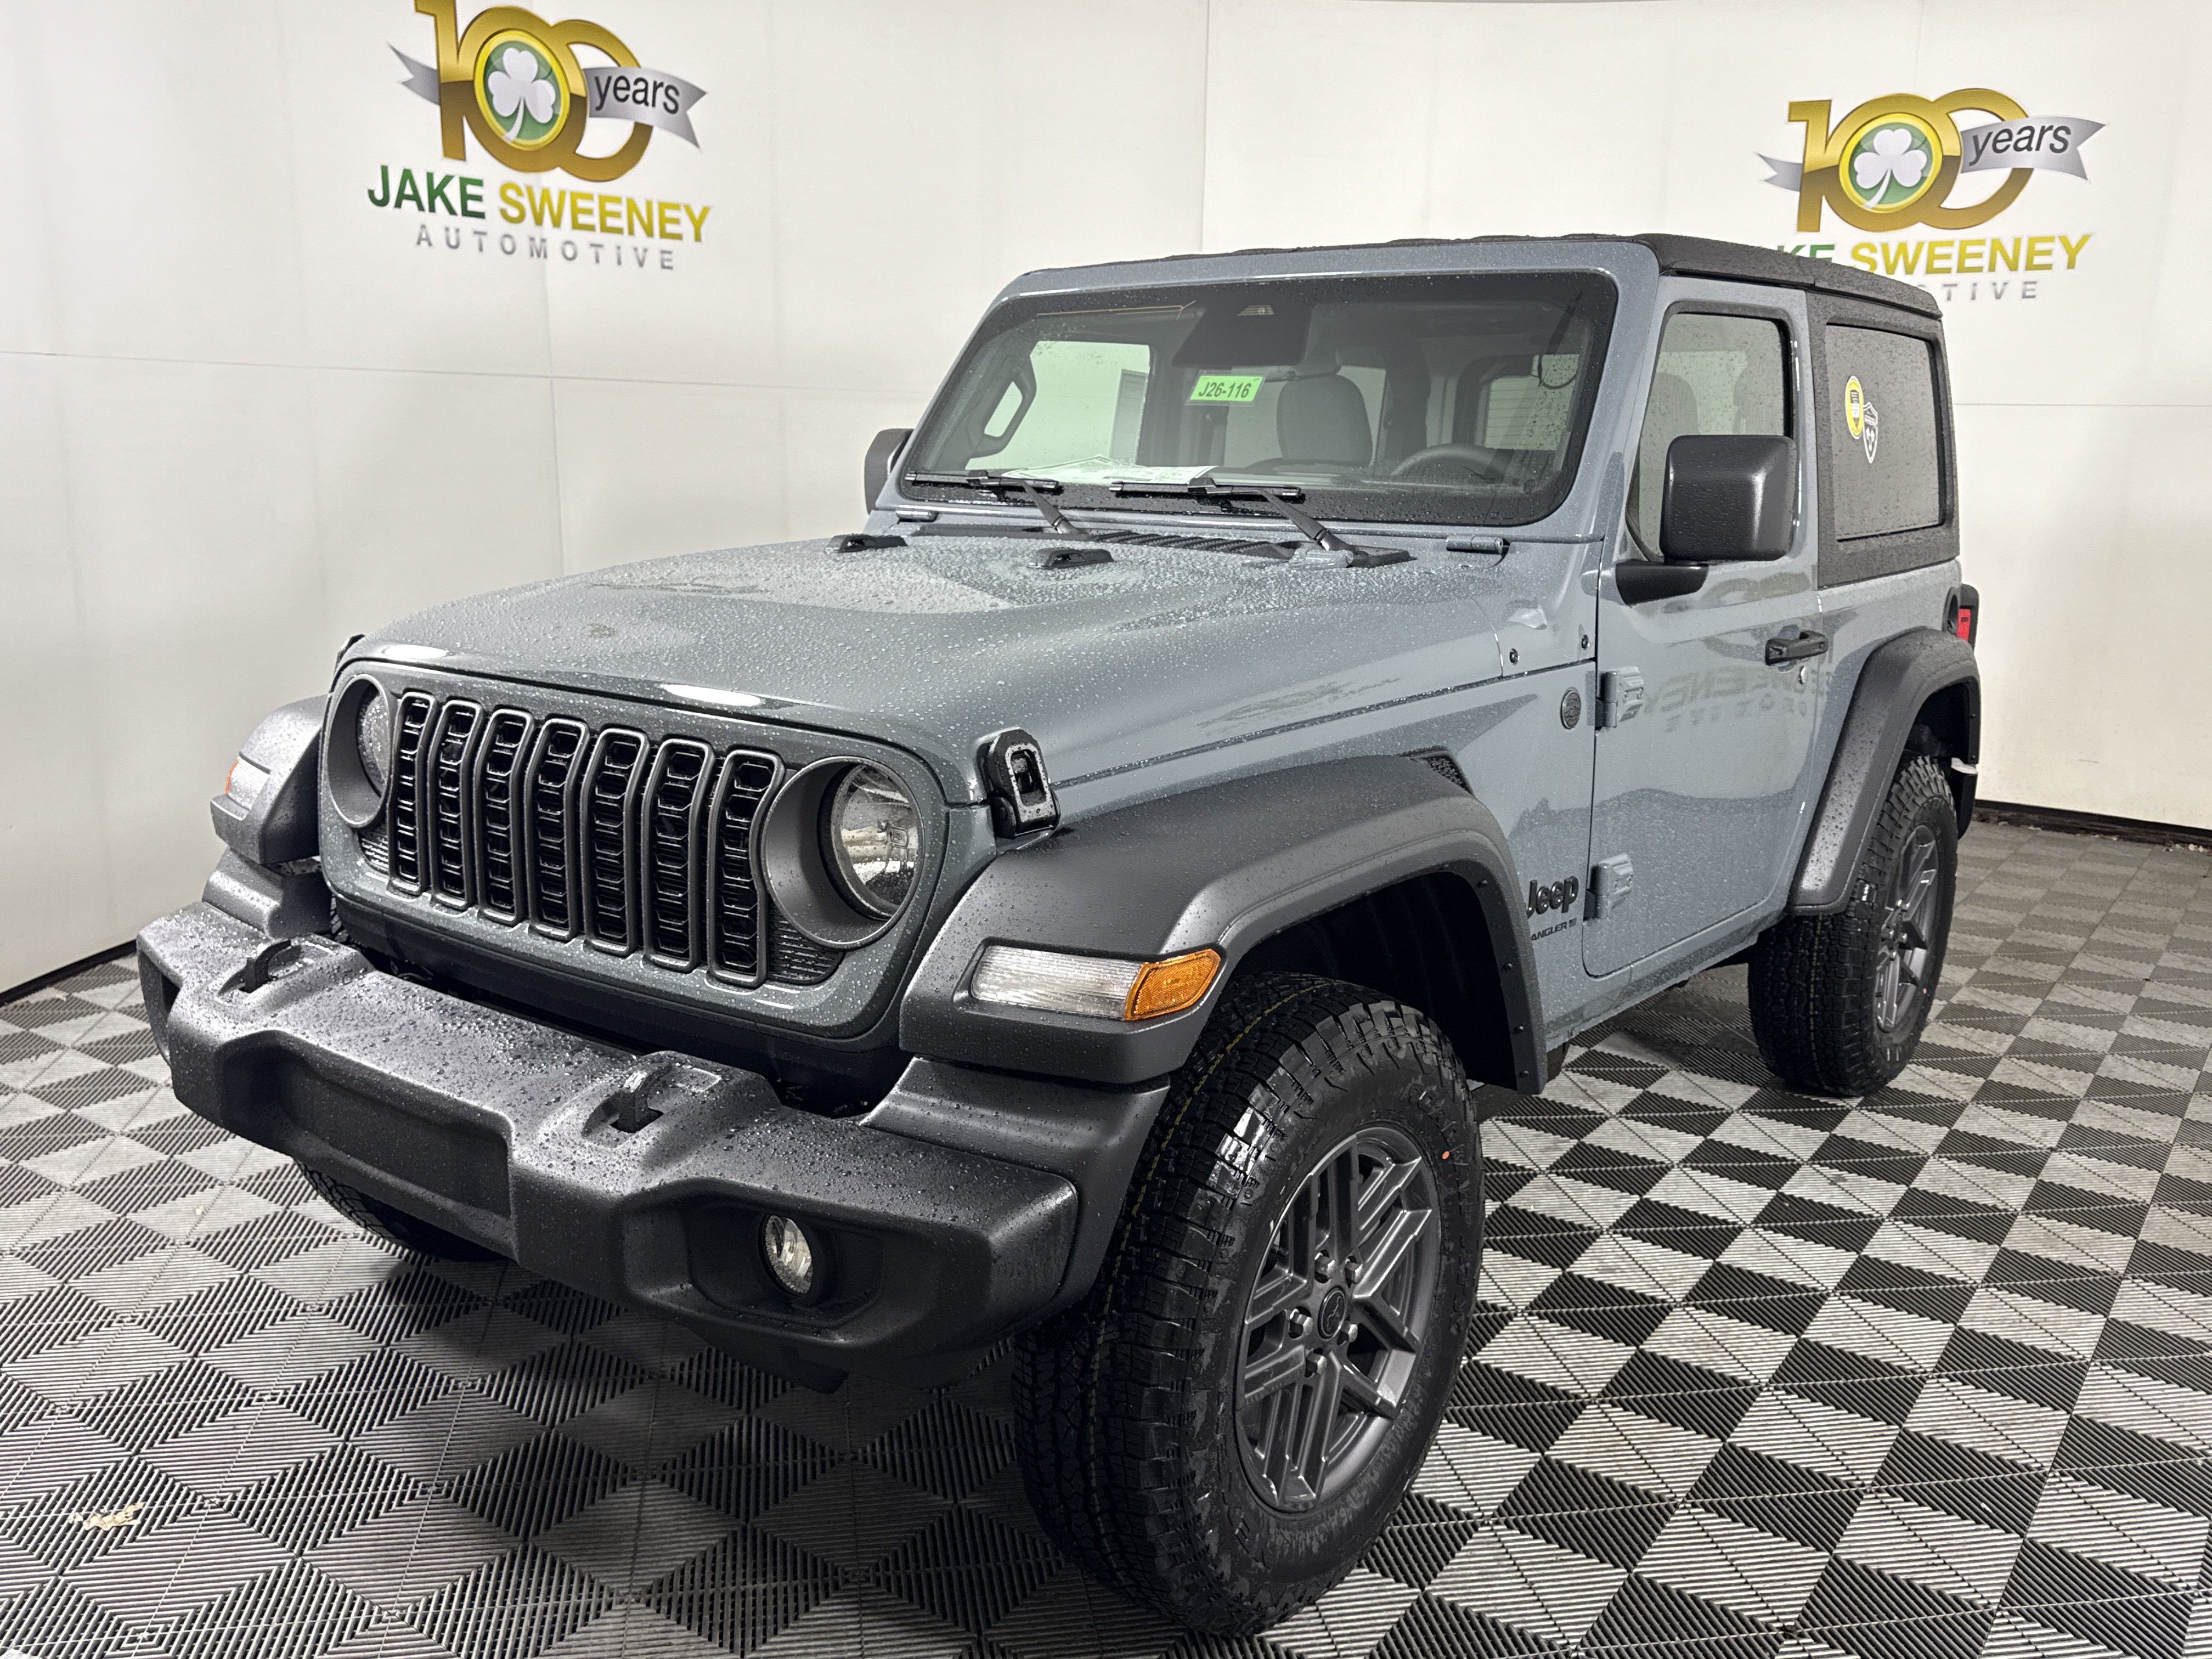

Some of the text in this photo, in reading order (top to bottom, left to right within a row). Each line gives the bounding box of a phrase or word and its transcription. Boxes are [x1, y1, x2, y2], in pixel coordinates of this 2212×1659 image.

[414, 0, 653, 182] 100
[595, 75, 680, 115] years
[1788, 88, 2034, 233] 100
[1968, 124, 2072, 166] years
[368, 165, 710, 243] JAKE SWEENEY
[415, 224, 674, 270] AUTOMOTIVE
[1850, 234, 2092, 275] SWEENEY
[1917, 280, 2039, 302] TIVE
[1198, 382, 1251, 398] J26-116
[1526, 876, 1579, 920] Jeep
[1531, 921, 1567, 941] ANGLER
